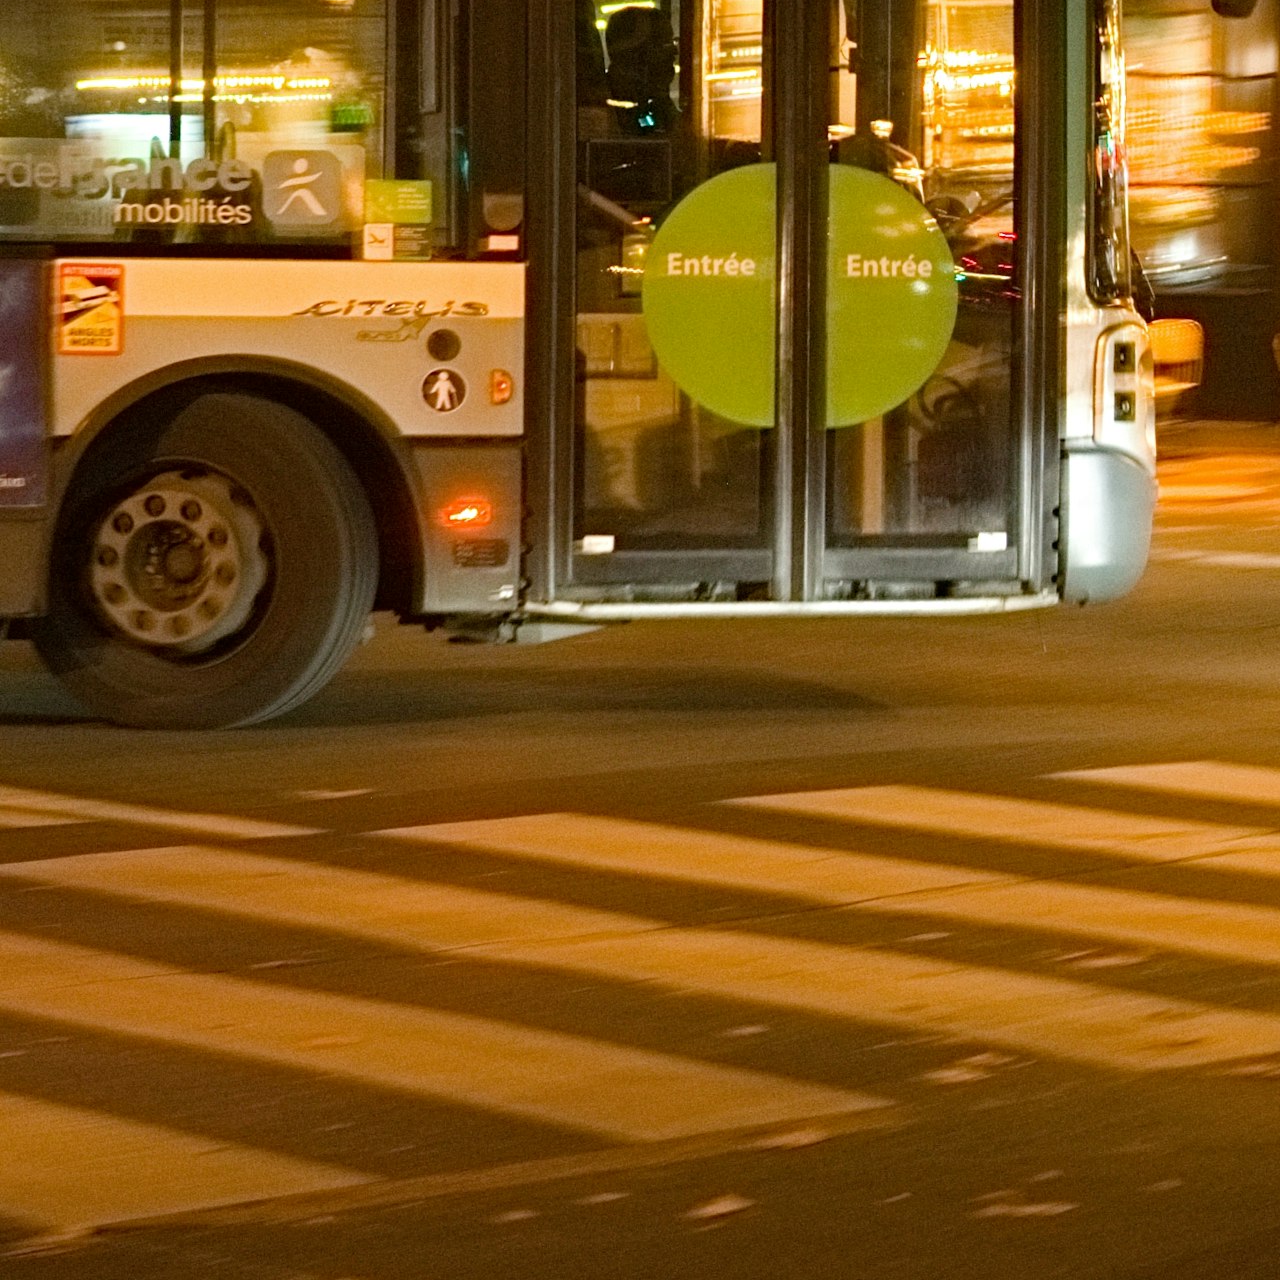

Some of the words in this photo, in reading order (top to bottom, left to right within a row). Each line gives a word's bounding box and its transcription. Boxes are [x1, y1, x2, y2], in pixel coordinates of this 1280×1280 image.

[112, 196, 253, 225] mobilités
[666, 251, 756, 276] Entrée
[846, 254, 933, 278] Entrée
